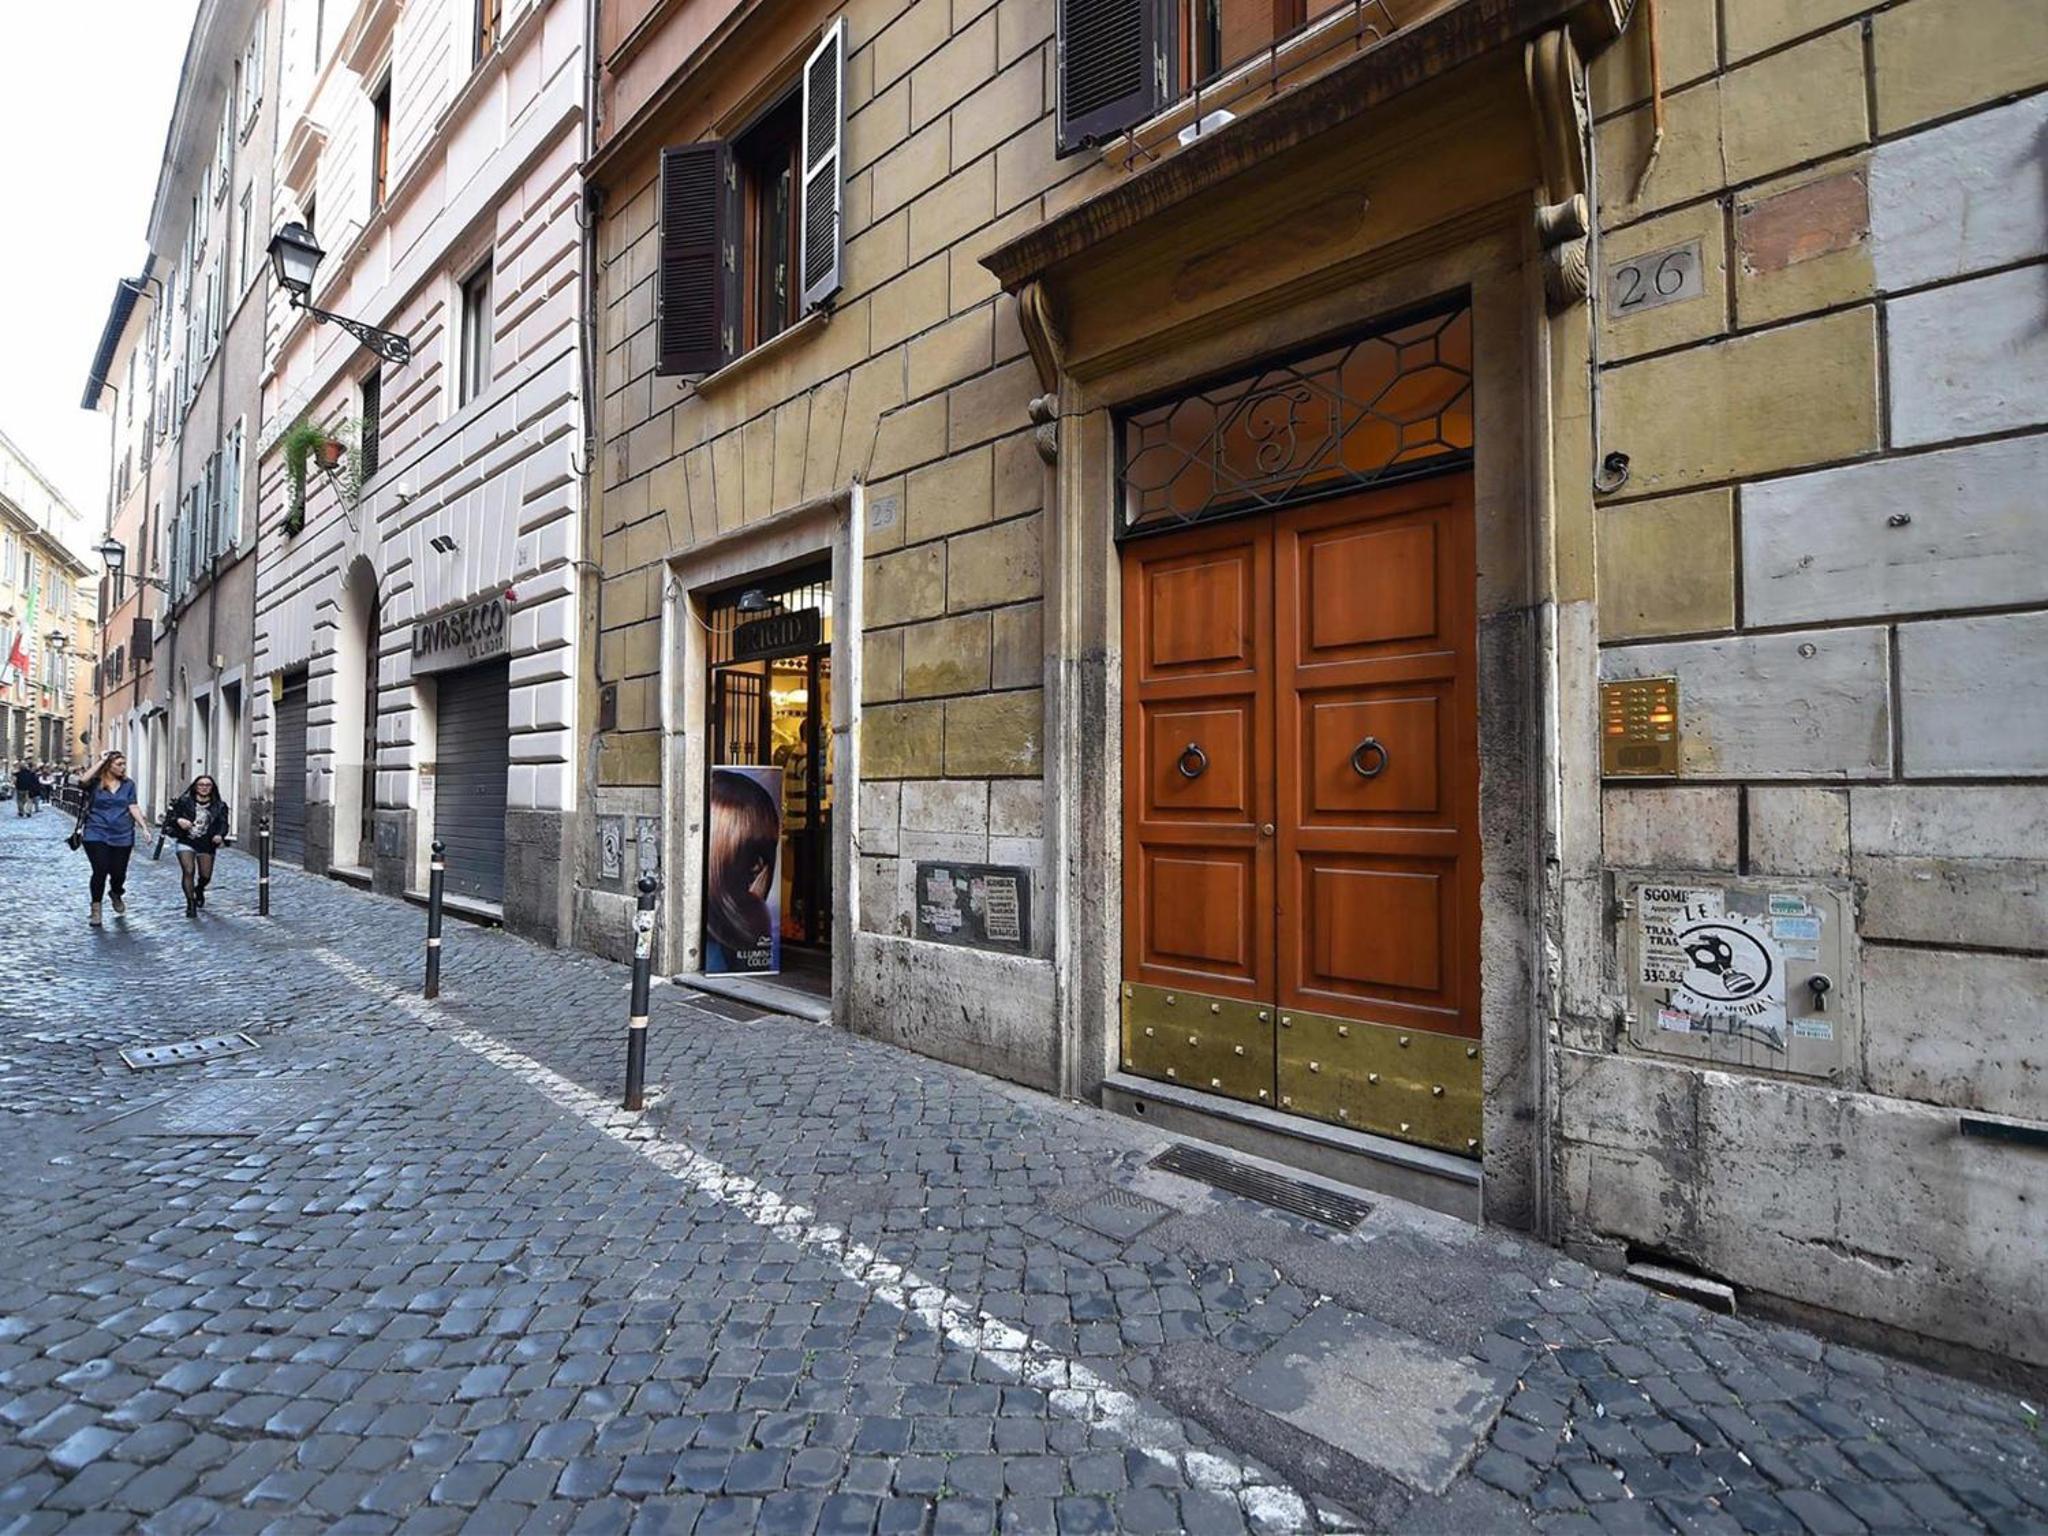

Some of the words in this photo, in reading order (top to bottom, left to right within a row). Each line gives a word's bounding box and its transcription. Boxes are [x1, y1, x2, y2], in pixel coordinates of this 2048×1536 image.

[1616, 250, 1692, 308] 26
[412, 600, 504, 659] LAVASECCO
[1644, 925, 1677, 936] TRAS
